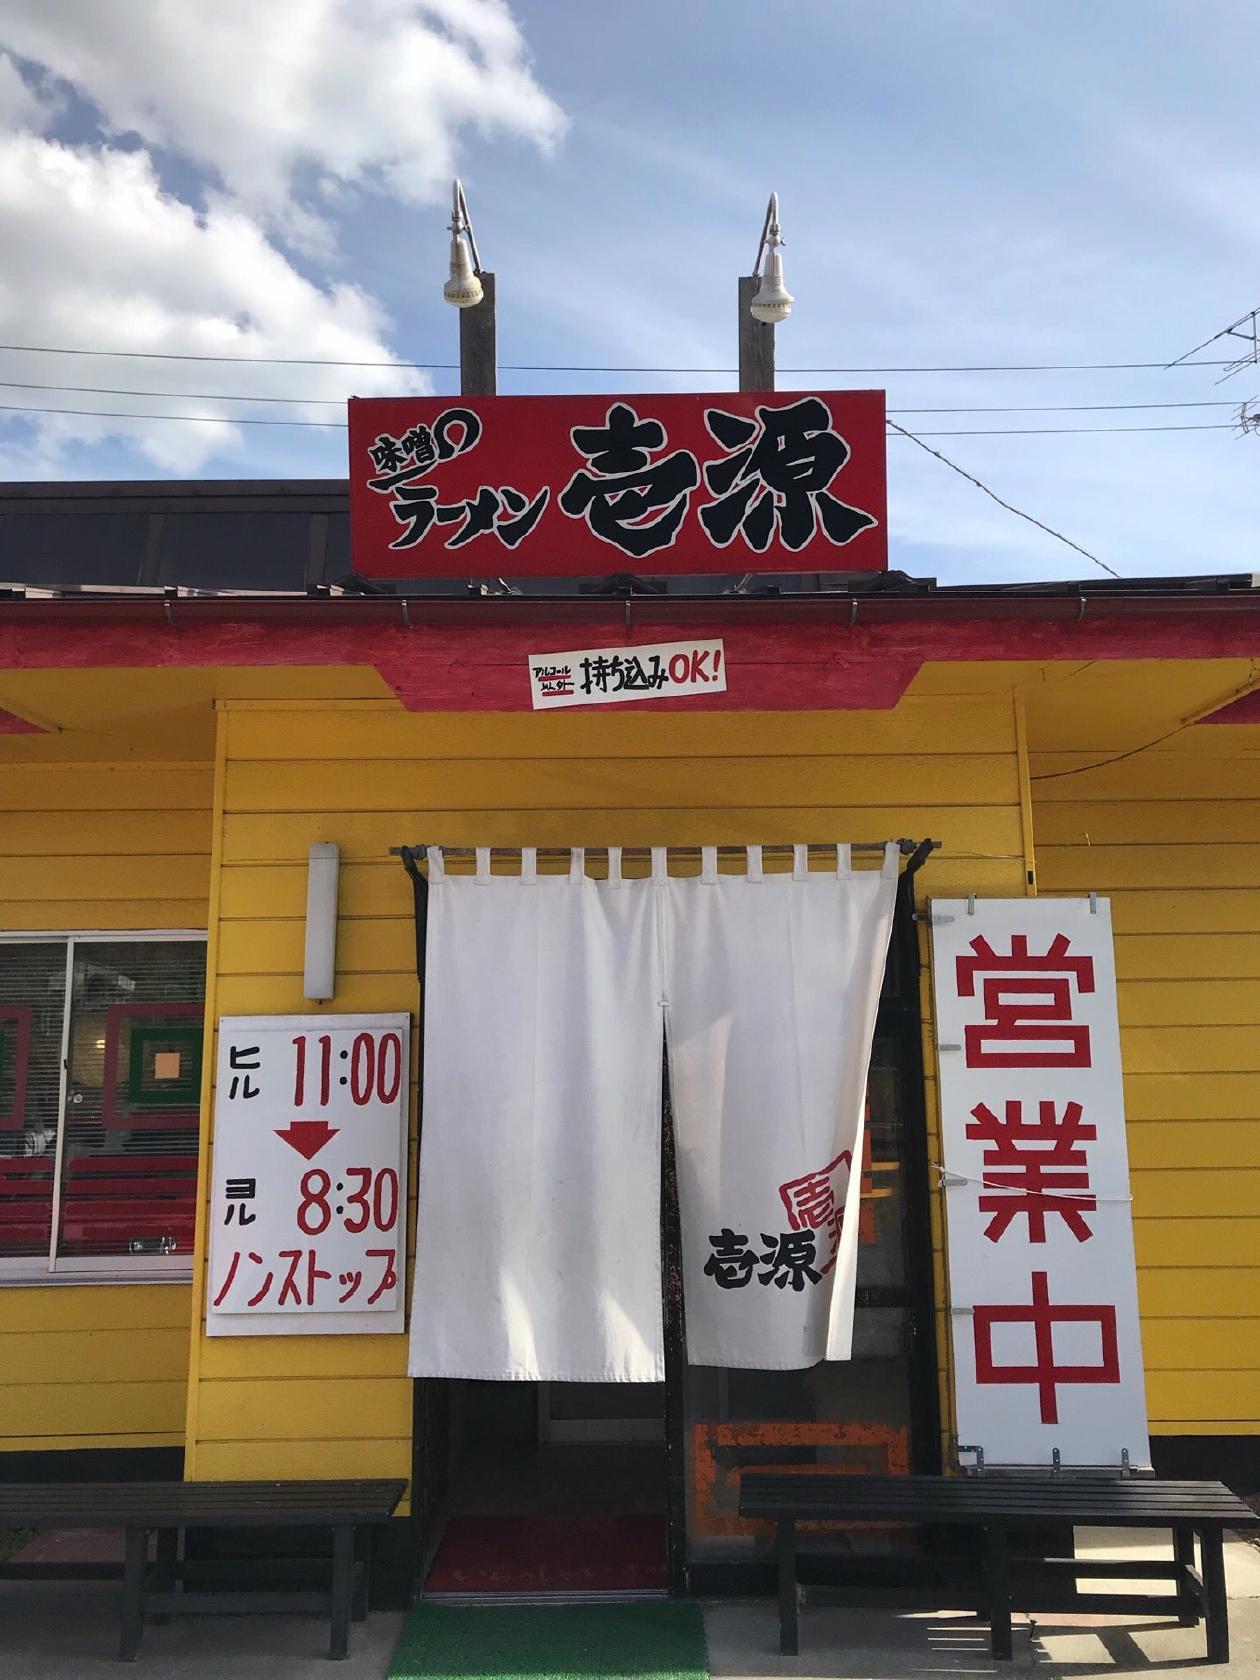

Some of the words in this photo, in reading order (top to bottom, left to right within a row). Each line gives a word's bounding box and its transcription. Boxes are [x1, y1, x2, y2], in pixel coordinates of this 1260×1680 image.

[367, 408, 482, 476] 味噌の
[558, 396, 879, 558] 壱源
[388, 485, 550, 550] ラーメン
[532, 665, 572, 678] アルコール
[540, 680, 575, 692] 以外
[229, 1045, 261, 1099] ヒル
[292, 1032, 402, 1107] 11:00
[224, 1177, 257, 1226] ヨル
[297, 1167, 399, 1236] 8:30
[955, 933, 1121, 1425] 営業中
[213, 1249, 397, 1307] ノンストップ
[703, 1228, 823, 1292] 壱源
